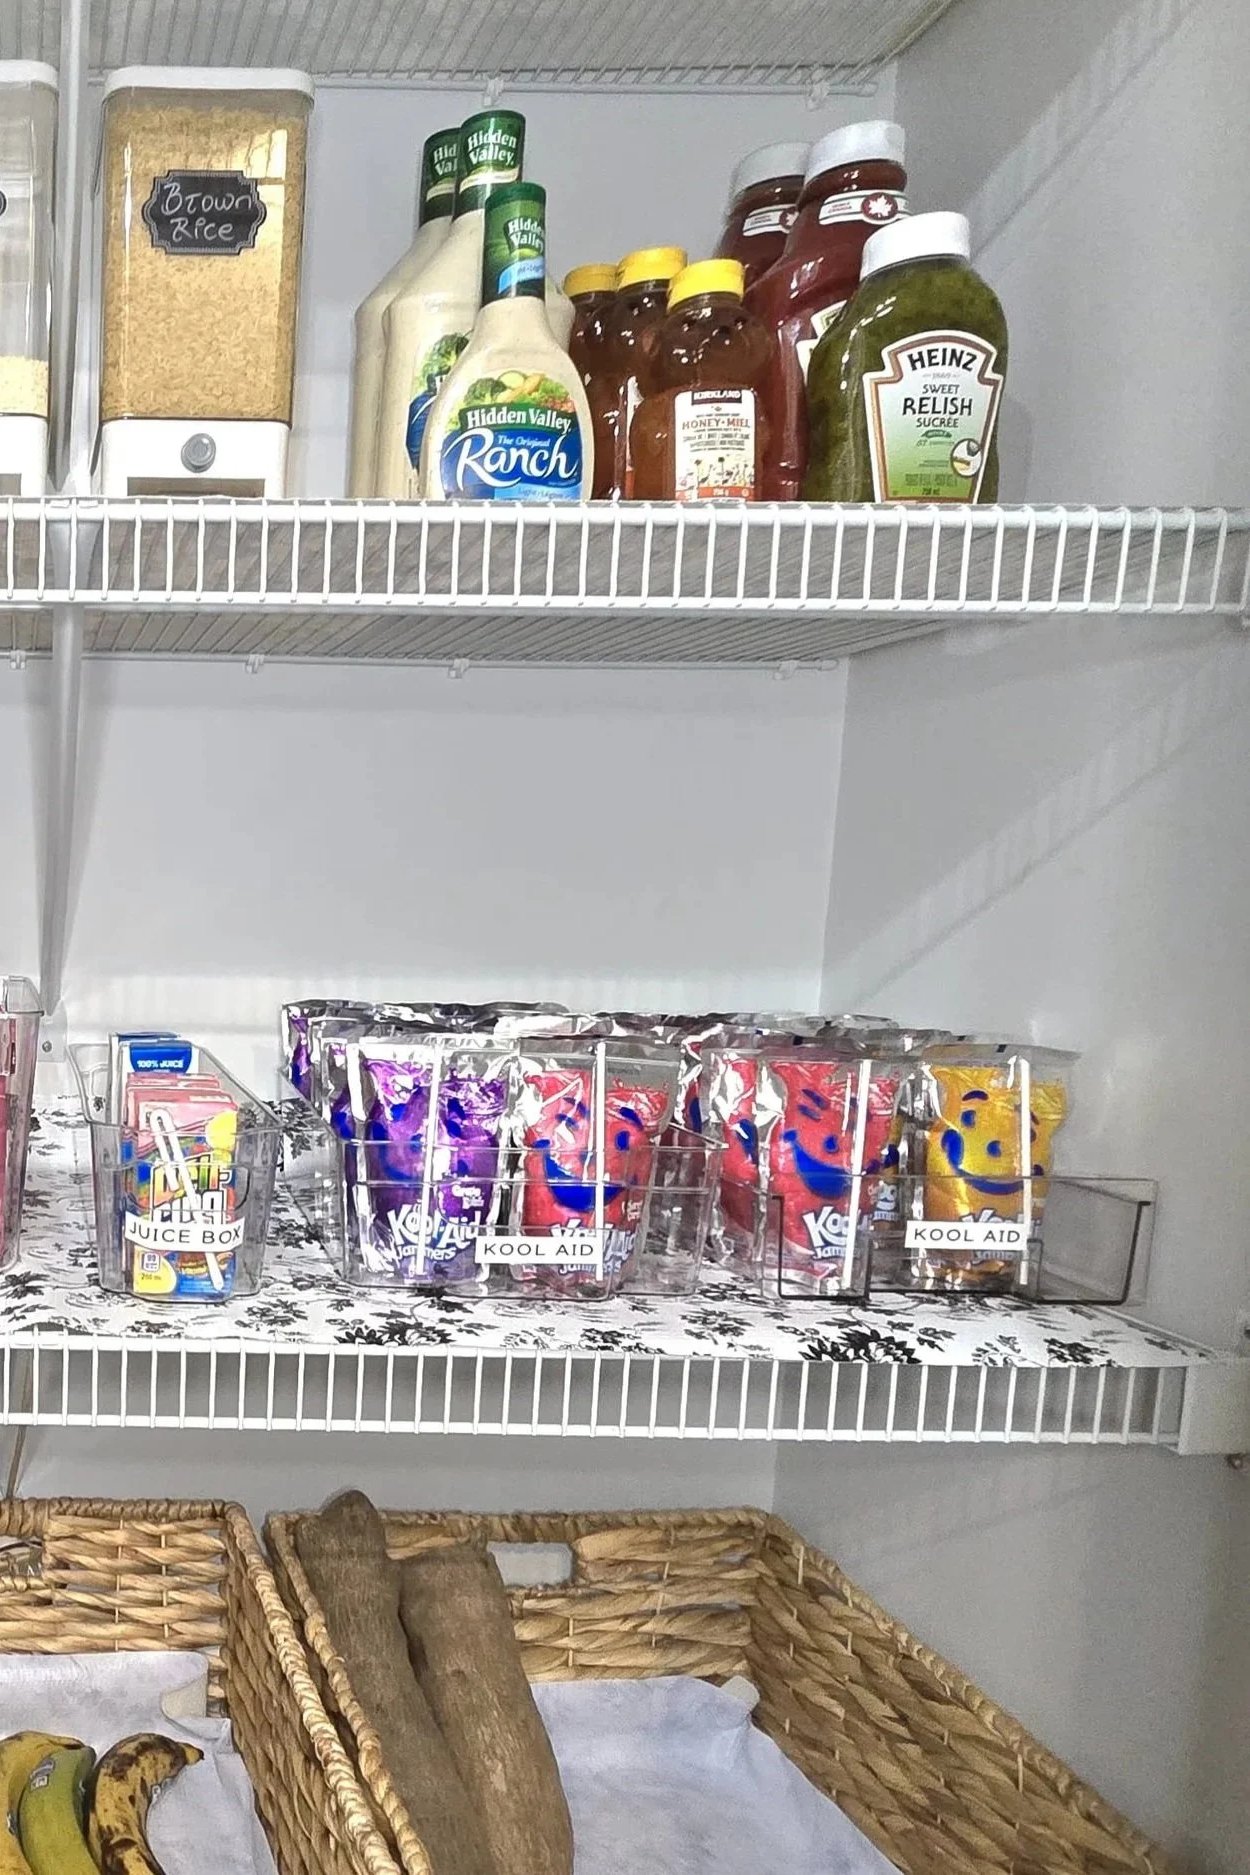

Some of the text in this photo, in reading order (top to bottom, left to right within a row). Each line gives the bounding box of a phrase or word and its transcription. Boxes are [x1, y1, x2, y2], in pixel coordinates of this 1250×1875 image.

[467, 130, 518, 151] Hidden
[433, 144, 458, 164] Hid
[160, 182, 252, 216] Brown
[169, 217, 235, 243] Rice
[907, 348, 978, 372] HEINZ
[922, 384, 960, 395] SWEET
[902, 397, 973, 416] RELISH
[466, 407, 527, 429] Hidden
[515, 436, 551, 449] Original
[443, 427, 578, 491] Ranch
[159, 1059, 184, 1069] JUICE
[129, 1222, 242, 1245] JUICE BOX
[914, 1228, 1021, 1243] KOOL AID
[484, 1243, 594, 1257] KOOL AID
